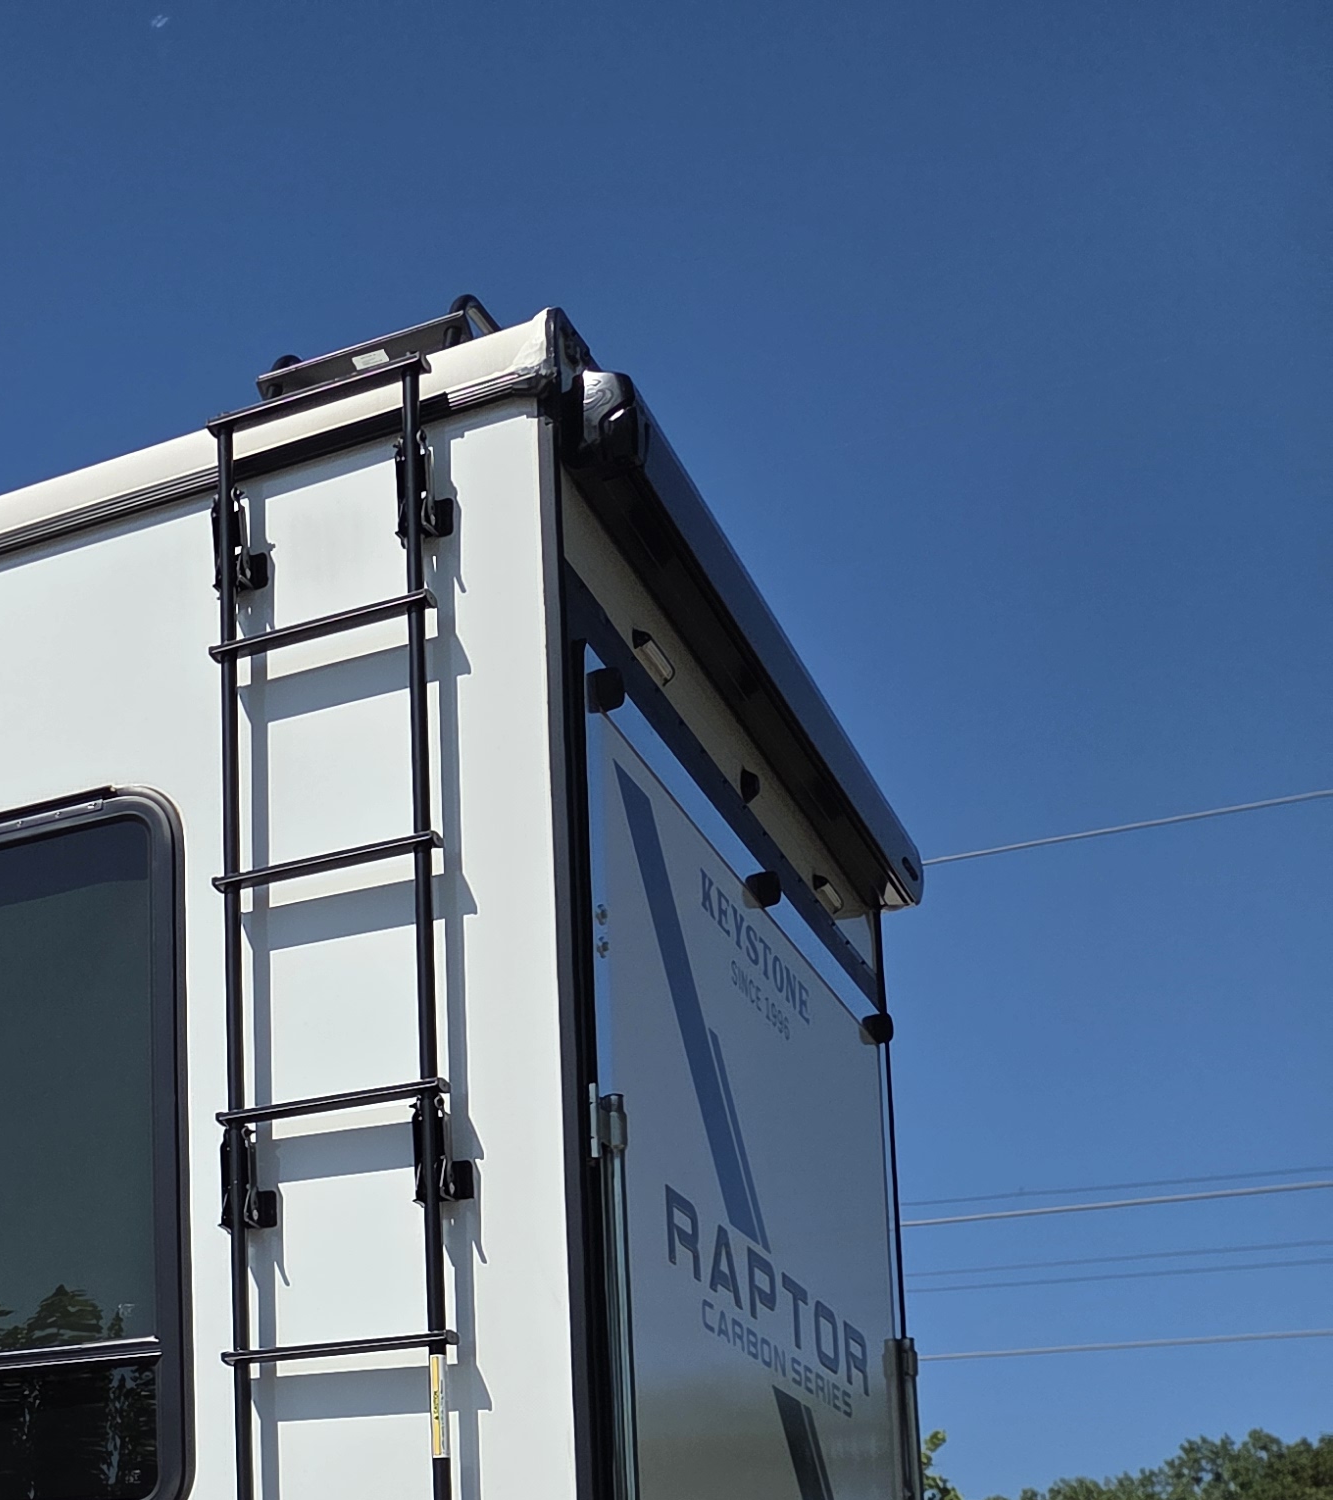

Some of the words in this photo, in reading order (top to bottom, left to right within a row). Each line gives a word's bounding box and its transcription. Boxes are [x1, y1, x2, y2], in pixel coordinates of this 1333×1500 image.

[699, 867, 810, 1025] KEYSTONE
[730, 959, 762, 1012] SINCE
[664, 1183, 870, 1397] RAPTOR
[701, 1298, 787, 1378] CARBON
[790, 1356, 852, 1419] SERIES
